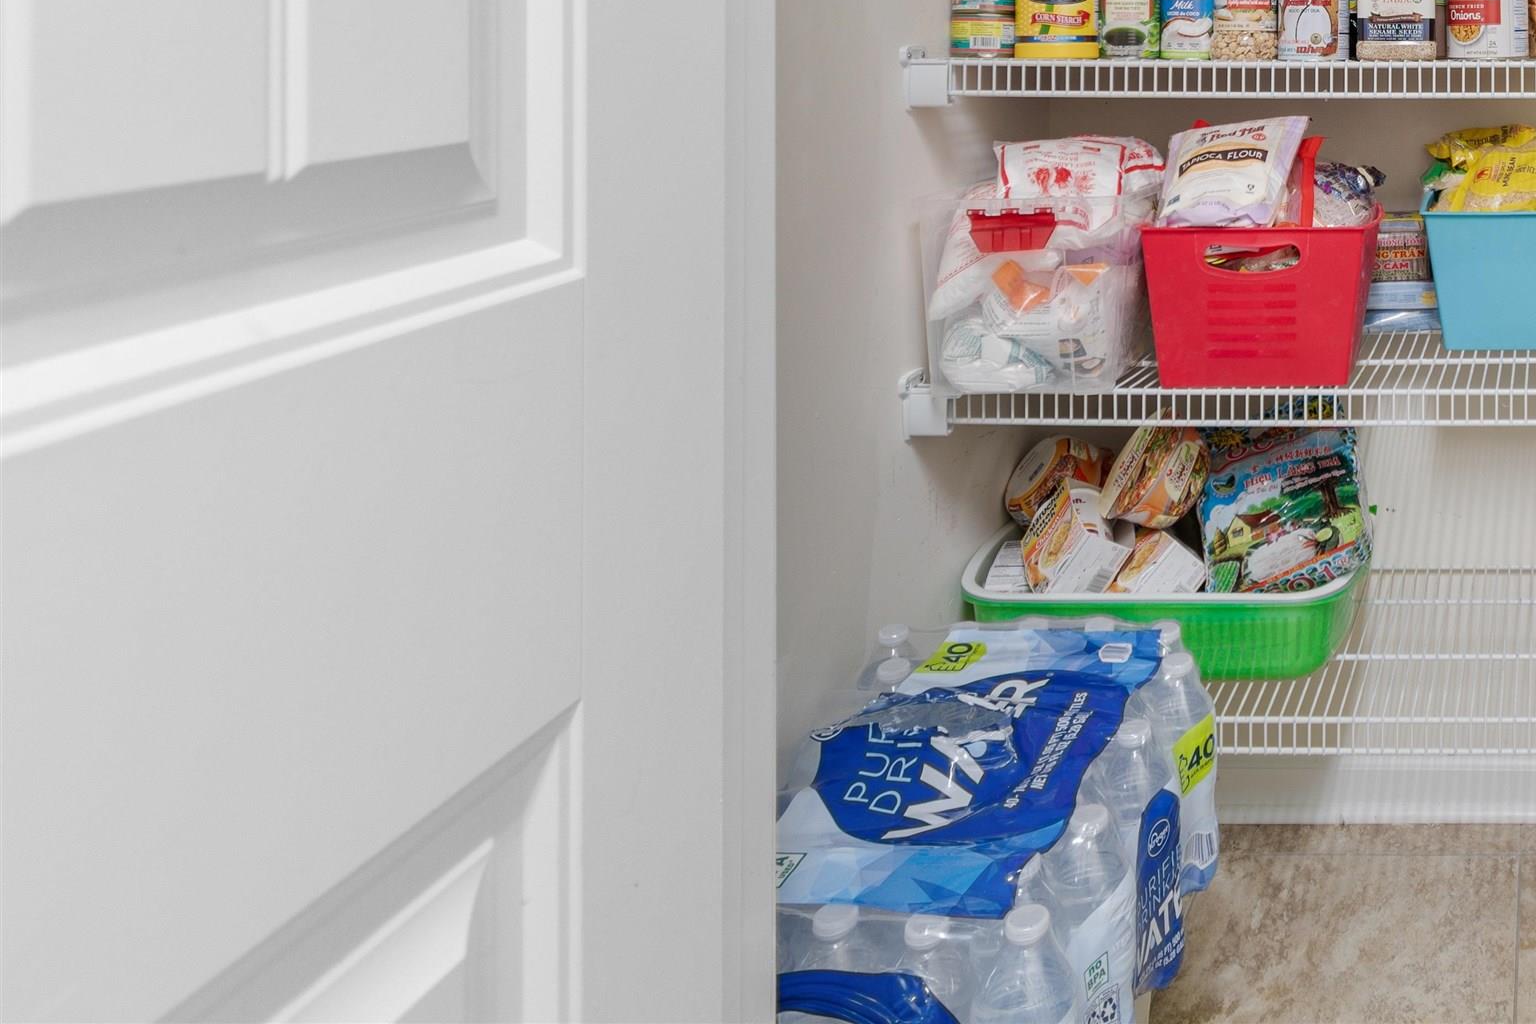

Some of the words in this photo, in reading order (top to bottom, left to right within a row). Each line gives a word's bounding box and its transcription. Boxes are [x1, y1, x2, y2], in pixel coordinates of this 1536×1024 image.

[1169, 0, 1195, 10] Milk
[1450, 9, 1481, 21] Onions
[1034, 12, 1056, 21] CORN
[1056, 14, 1082, 24] STARCH
[1208, 131, 1237, 143] Red
[1239, 125, 1266, 137] Mill
[1181, 151, 1223, 171] TAPIOCA
[1226, 149, 1263, 161] FLOUR
[1028, 486, 1065, 534] Maruchan
[942, 642, 973, 663] 40
[1188, 733, 1215, 771] 40
[1148, 827, 1170, 851] Kroger
[1088, 960, 1102, 977] no
[1087, 968, 1106, 991] BPA
